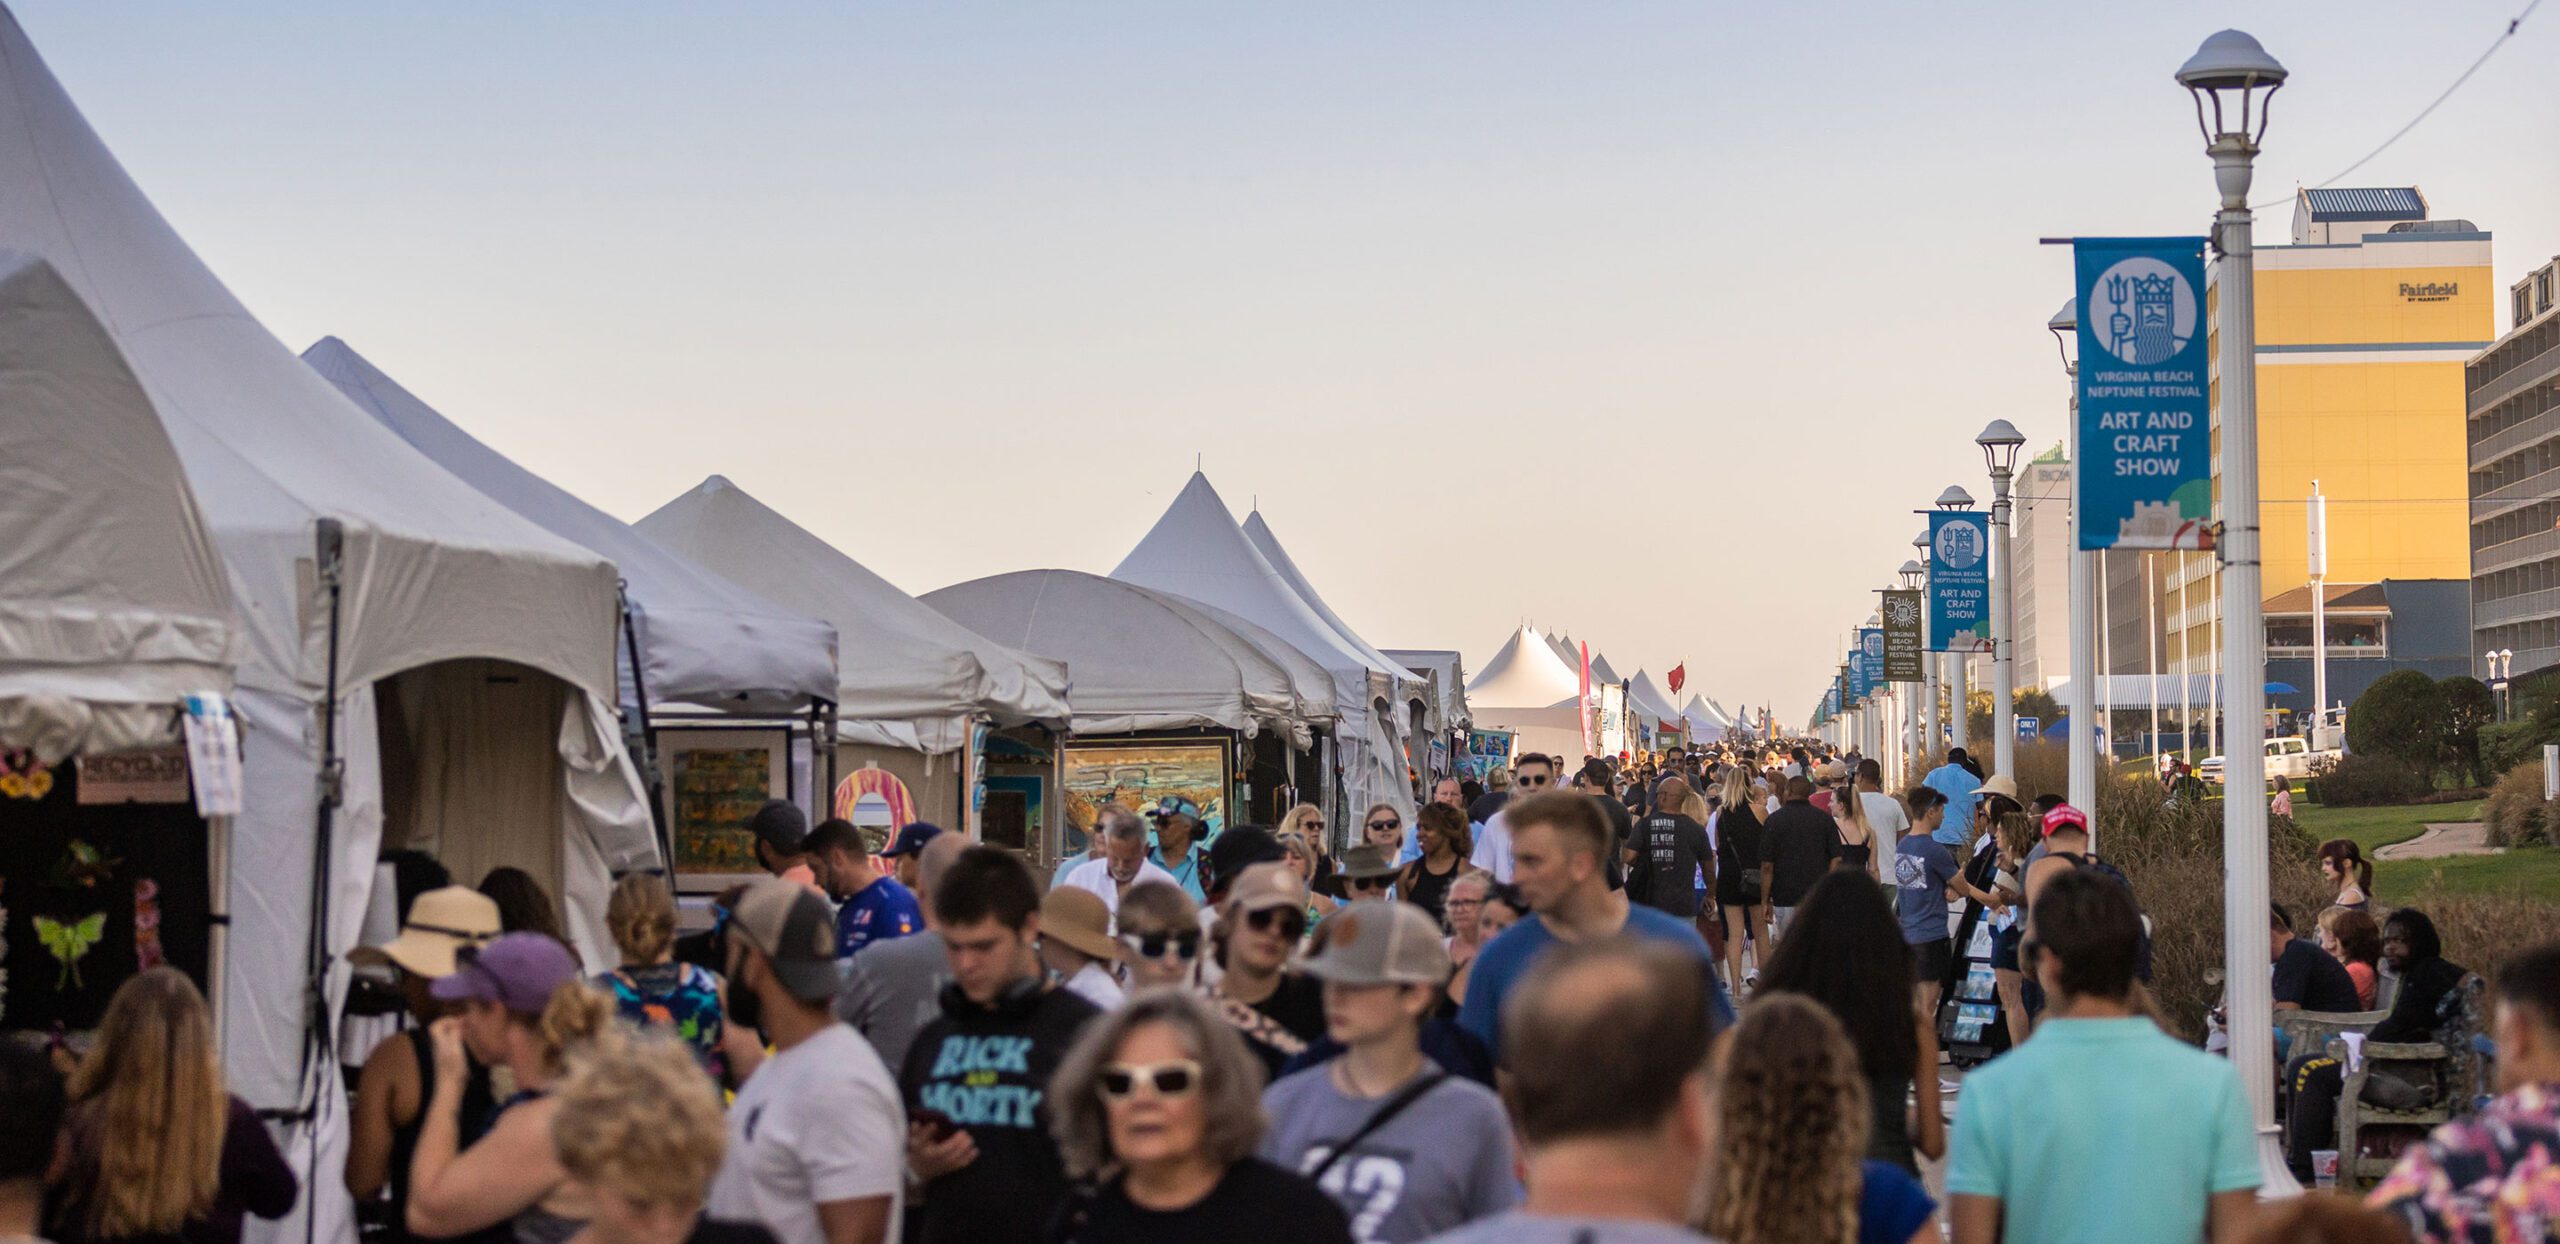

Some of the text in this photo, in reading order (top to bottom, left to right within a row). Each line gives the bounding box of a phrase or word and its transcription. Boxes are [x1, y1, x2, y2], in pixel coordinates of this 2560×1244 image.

[2399, 283, 2458, 296] Fairfield
[2095, 371, 2194, 382] VIRGINIA BEACH
[2088, 386, 2202, 398] NEPTUNE FESTIVAL
[2099, 412, 2193, 429] ART AND
[2113, 435, 2180, 453] CRAFT
[2114, 458, 2180, 476] SHOW
[1940, 589, 1982, 599] ART AND
[1946, 600, 1976, 609] CRAFT
[1946, 610, 1976, 619] SHOW
[2020, 721, 2036, 729] ONLY
[932, 1036, 1033, 1077] RICK
[921, 1082, 1041, 1127] MORTY
